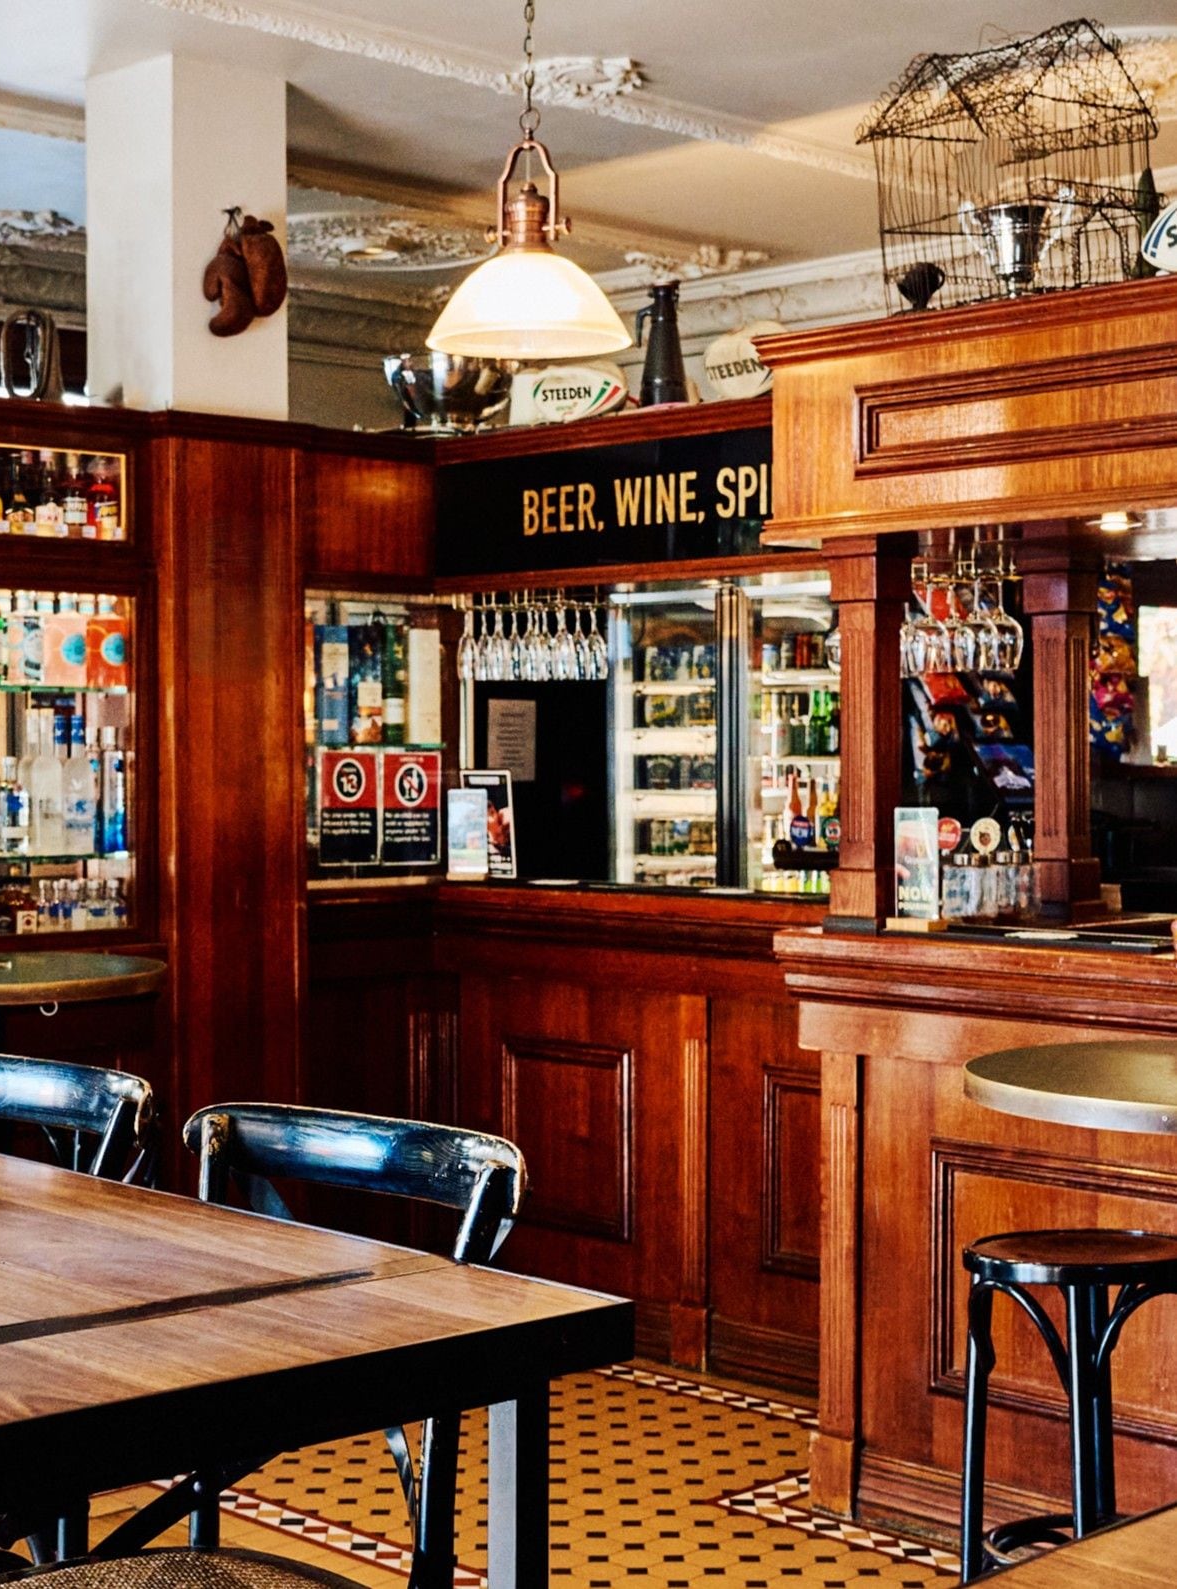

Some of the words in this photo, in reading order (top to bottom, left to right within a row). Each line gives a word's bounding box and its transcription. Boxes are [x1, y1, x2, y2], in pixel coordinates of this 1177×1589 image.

[542, 386, 592, 402] STEEDEN
[523, 483, 604, 536] BEER,
[614, 471, 705, 526] WINE,
[716, 463, 773, 518] SPI
